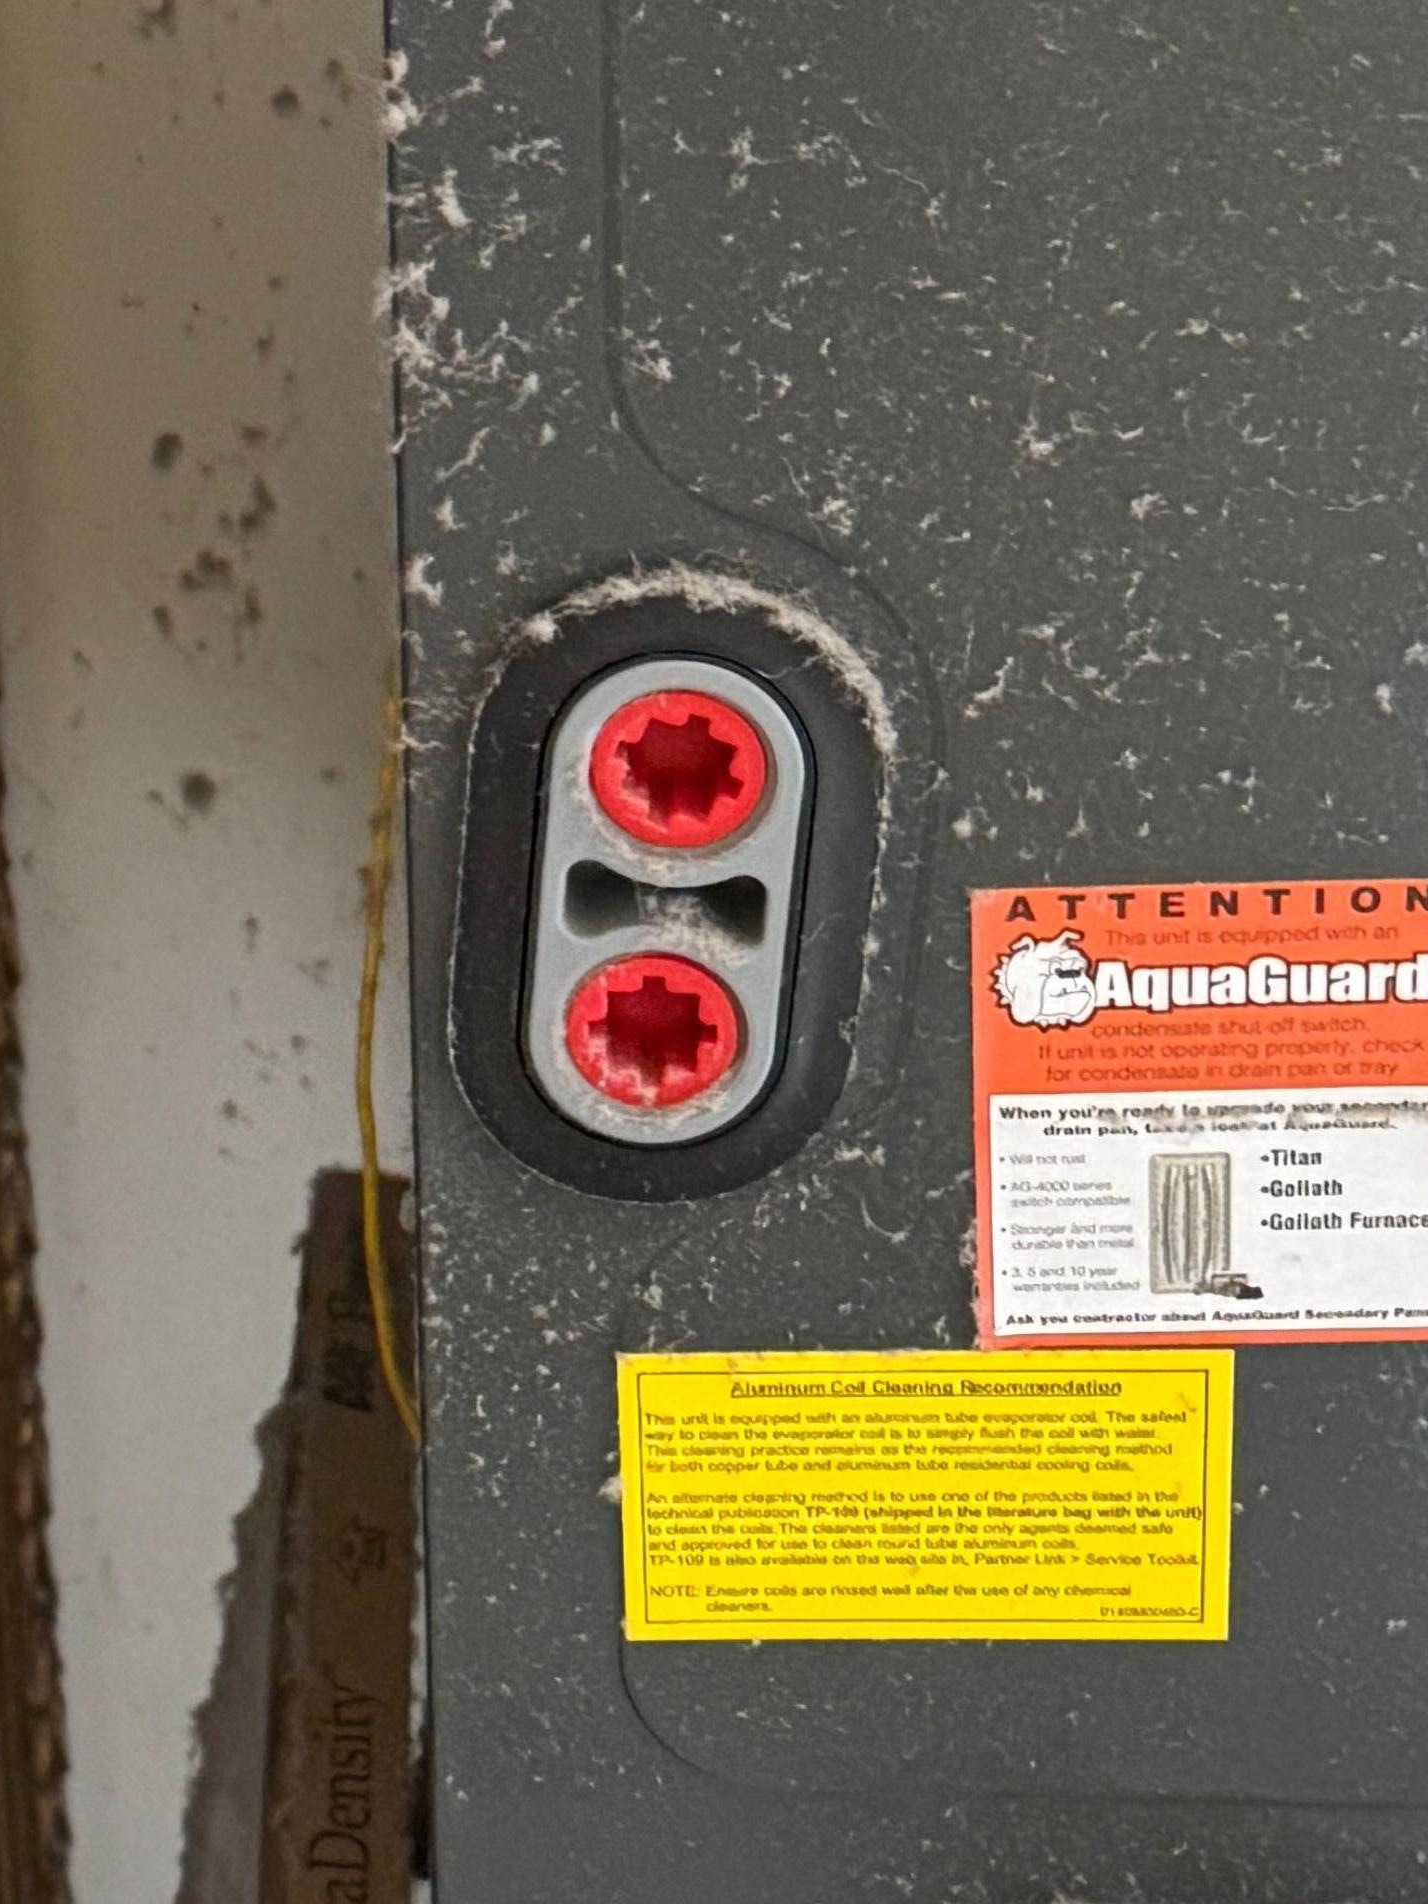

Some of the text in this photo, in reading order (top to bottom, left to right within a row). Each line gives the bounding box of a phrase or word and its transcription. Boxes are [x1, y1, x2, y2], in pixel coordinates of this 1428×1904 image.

[1107, 926, 1399, 946] This unit is equipped with an
[999, 1107, 1052, 1119] When
[1269, 1149, 1322, 1167] Titan
[1269, 1180, 1343, 1198] Goliath
[1269, 1212, 1342, 1231] Goliath
